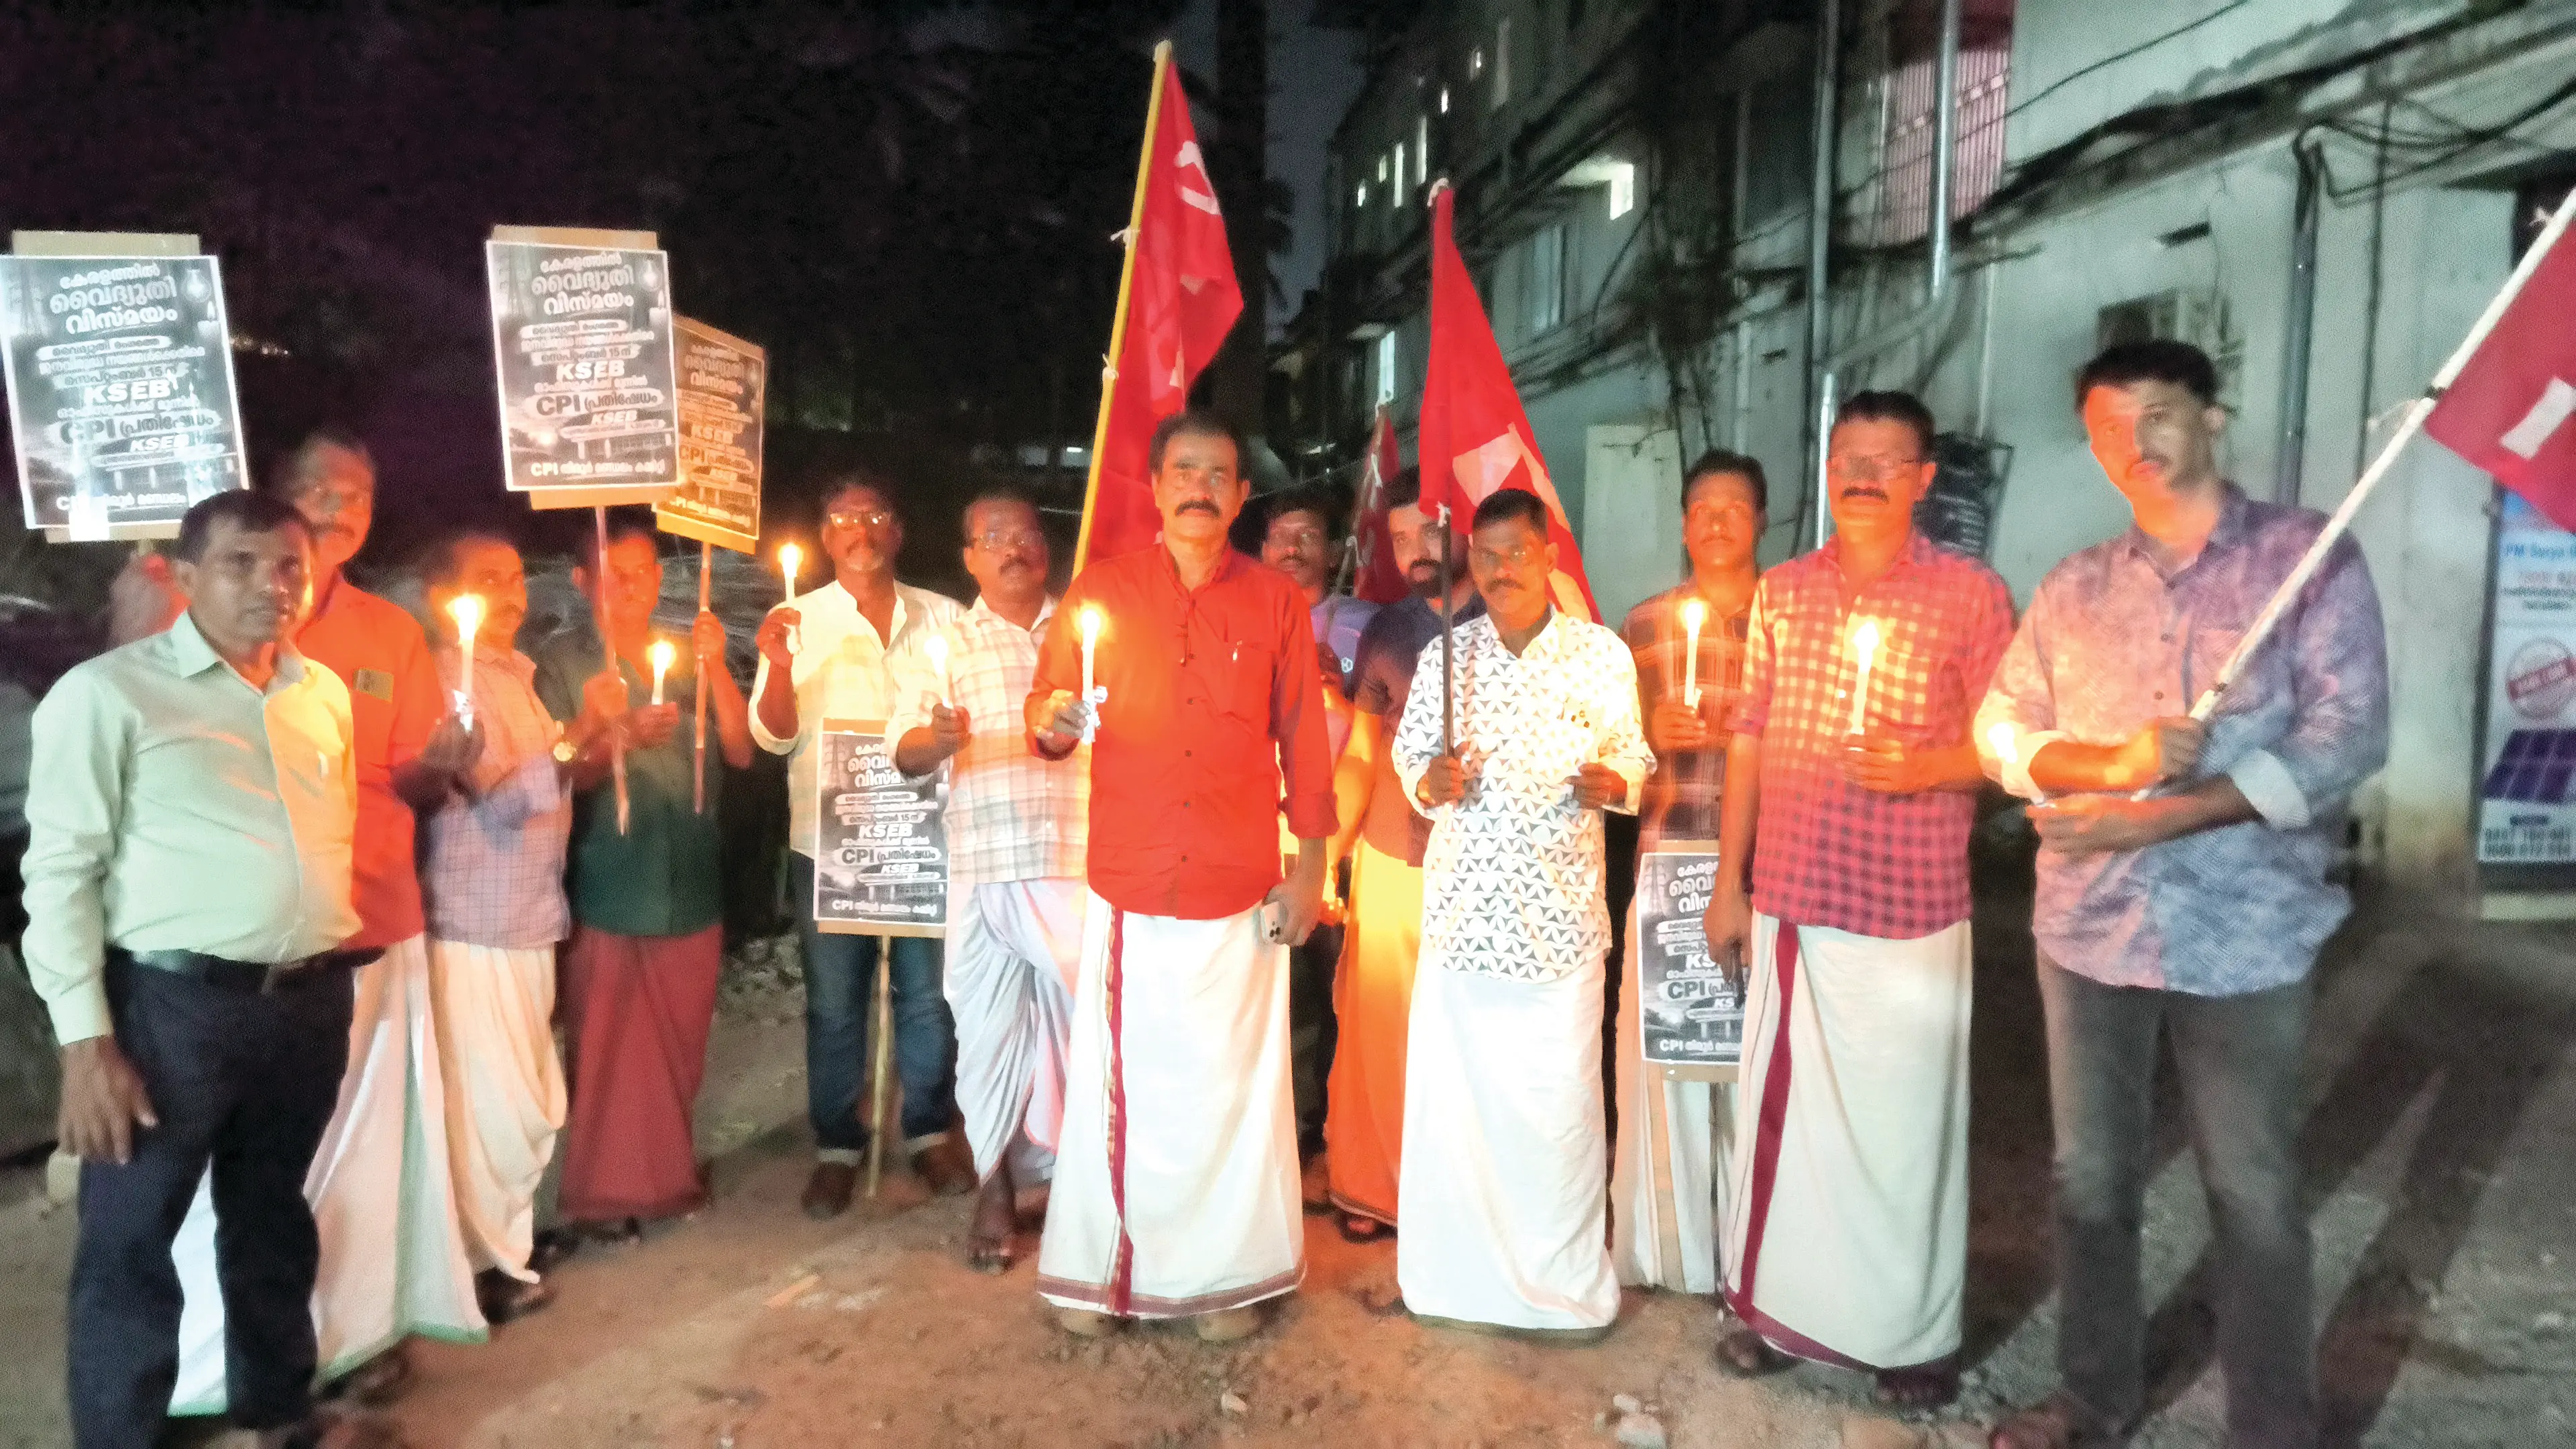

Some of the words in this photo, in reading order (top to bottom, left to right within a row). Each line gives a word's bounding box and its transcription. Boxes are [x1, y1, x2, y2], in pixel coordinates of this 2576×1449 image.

[531, 264, 634, 295] വൈദ്യുതി
[50, 274, 177, 314] വൈദ്യുതി
[543, 287, 634, 316] വിസ്മയം
[66, 306, 178, 334] വിസ്മയം
[609, 347, 620, 357] 15
[149, 366, 163, 378] 15
[556, 360, 625, 381] KSEB
[83, 379, 170, 407] KSEB
[537, 394, 580, 416] CPI
[584, 392, 658, 413] പ്രതിഷേധം
[591, 410, 637, 425] KSEB
[60, 419, 116, 444] CPI
[692, 424, 734, 445] KSEB
[130, 434, 189, 453] KSEB
[680, 445, 705, 463] CPI
[531, 462, 558, 476] CPI
[855, 769, 903, 788] വിസ്മ
[859, 822, 912, 838] KSEB
[842, 849, 875, 864] CPI
[881, 863, 920, 873] KSEB
[1677, 861, 1718, 877] കേരള
[832, 900, 854, 911] CPI
[1686, 953, 1717, 969] KS
[1668, 981, 1705, 1000] CPI
[1714, 998, 1735, 1008] KS
[1660, 1039, 1684, 1051] CPI
